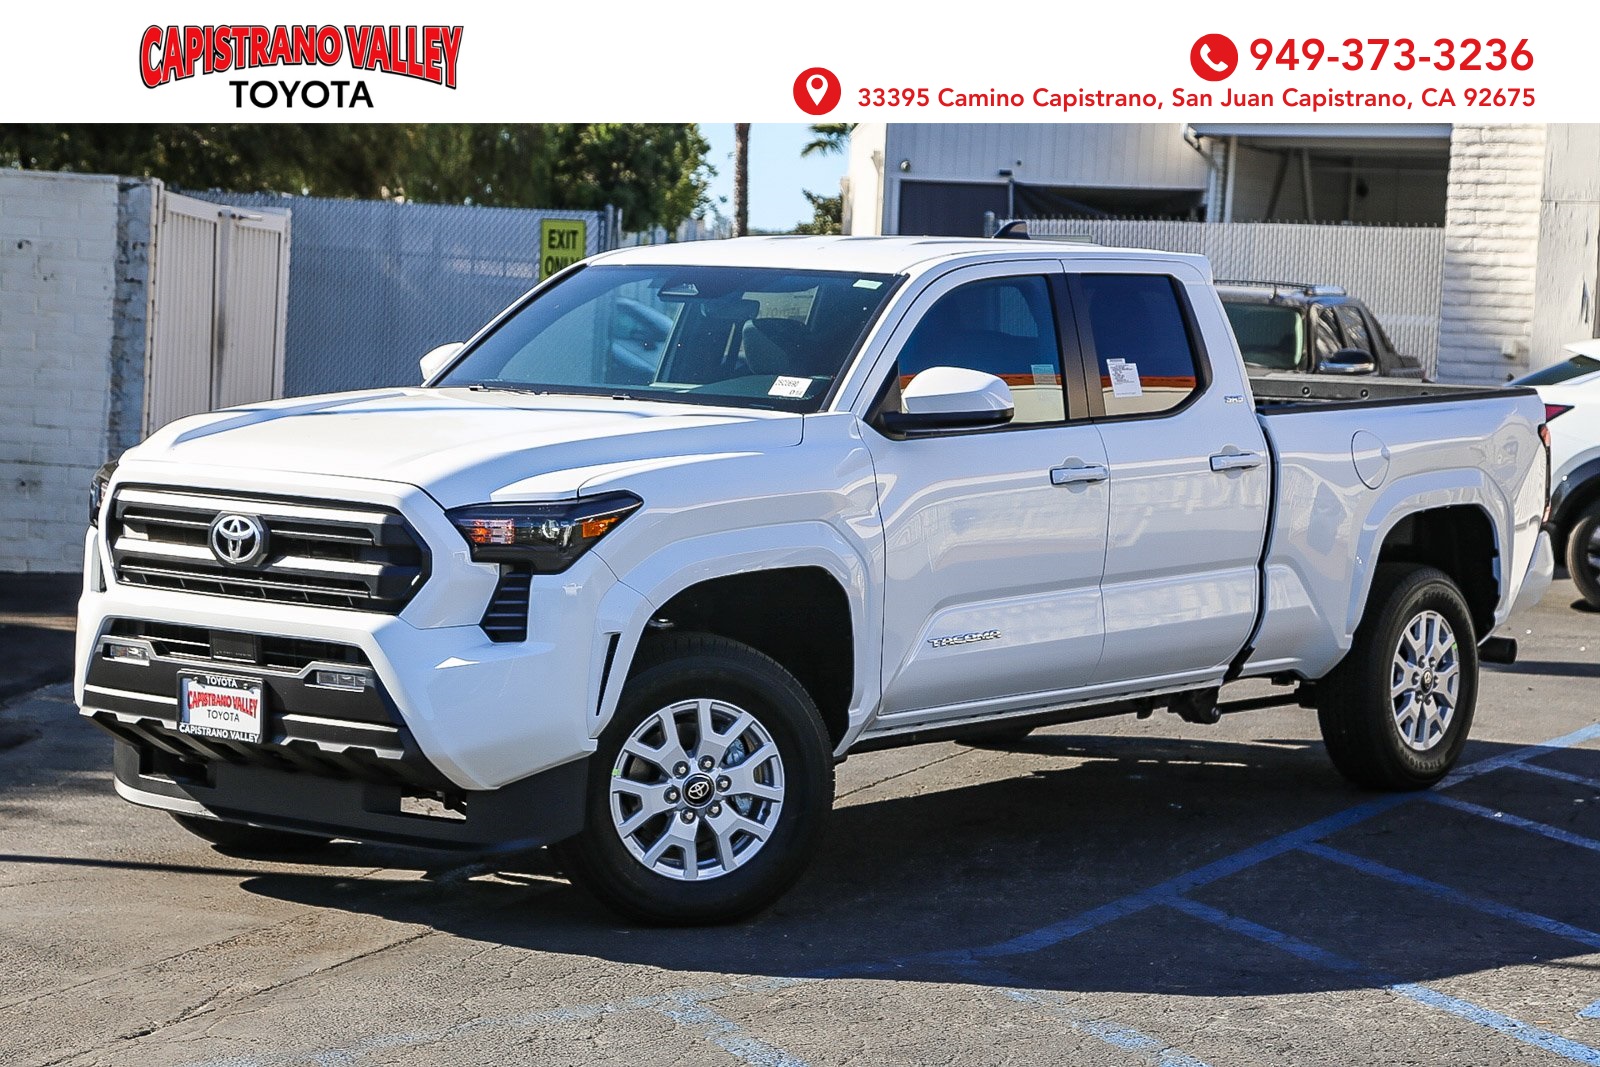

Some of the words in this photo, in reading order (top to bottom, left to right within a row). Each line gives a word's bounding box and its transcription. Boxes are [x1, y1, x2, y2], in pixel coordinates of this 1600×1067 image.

[547, 229, 579, 249] EXIT
[544, 256, 579, 275] ON
[927, 630, 1002, 648] TACOMA
[205, 675, 238, 688] TOYOTA
[187, 690, 232, 710] CAPISTRANO
[233, 696, 258, 718] VALLEY
[207, 709, 240, 722] TOYOTA
[179, 724, 229, 739] CAPISTRANO
[229, 731, 260, 743] VALLEY
